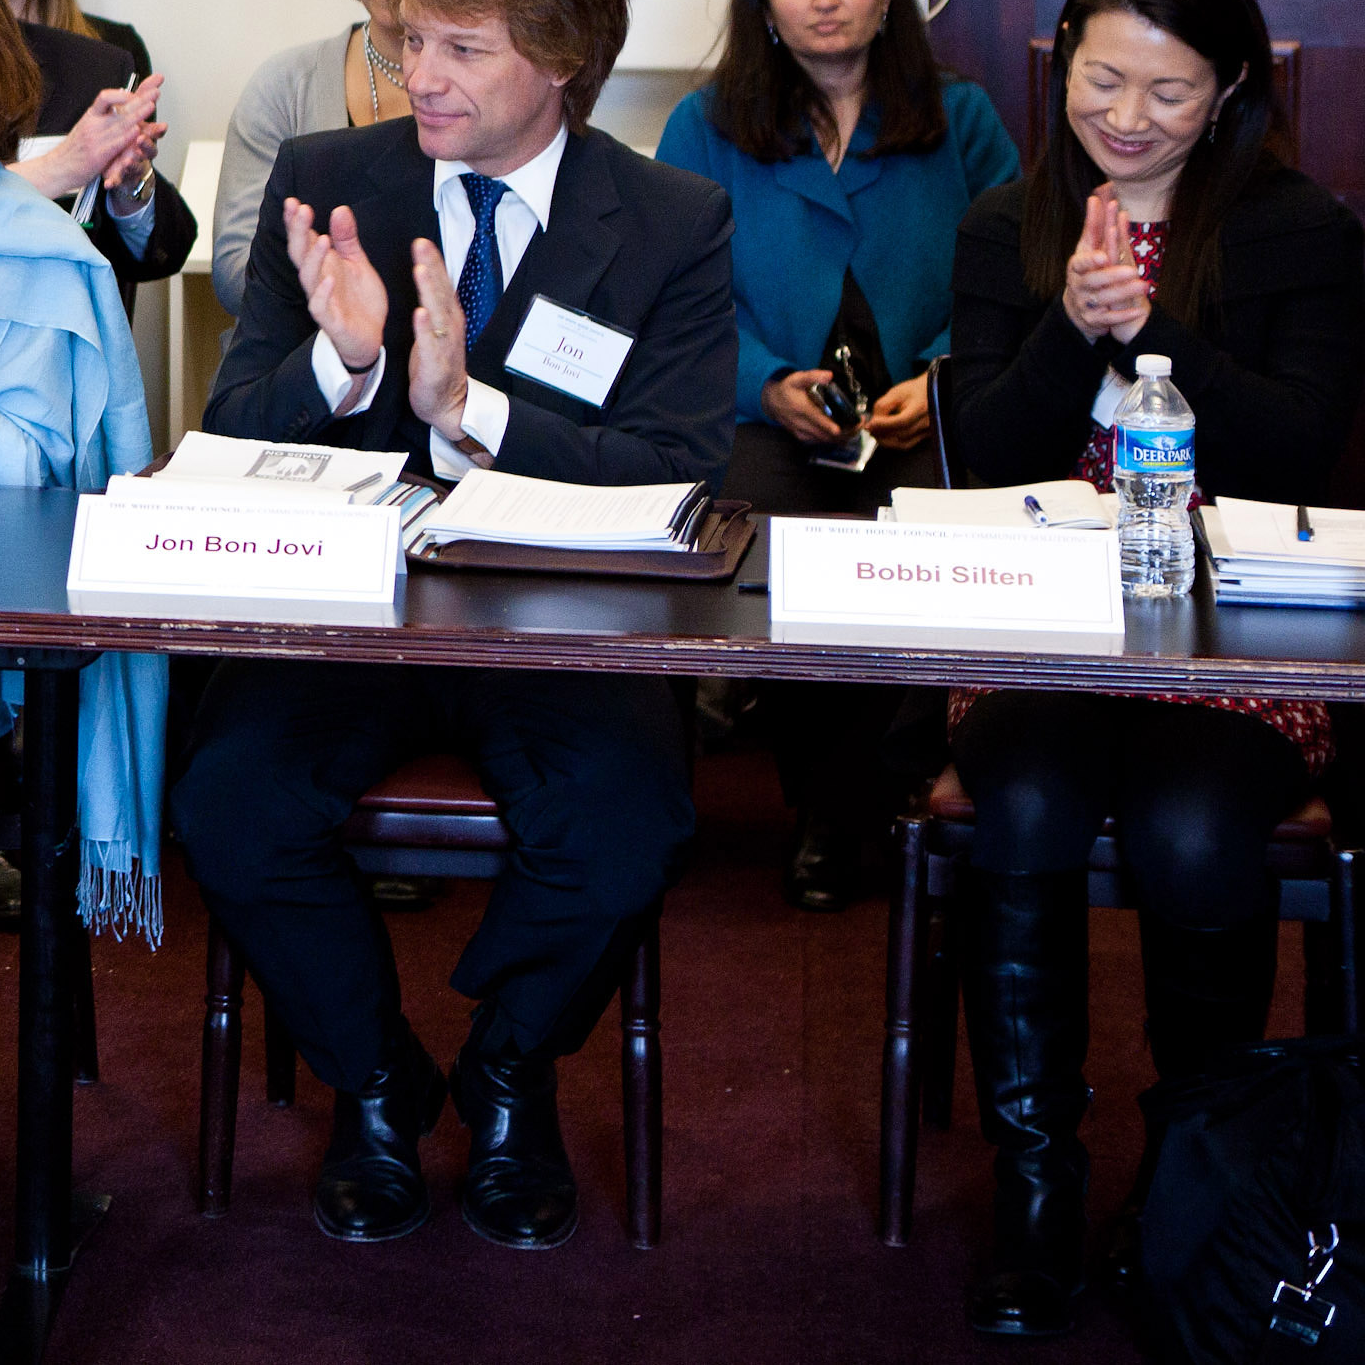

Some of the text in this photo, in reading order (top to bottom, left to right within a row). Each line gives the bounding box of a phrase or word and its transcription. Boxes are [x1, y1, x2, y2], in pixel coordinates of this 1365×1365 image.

[552, 337, 585, 361] Jon
[542, 356, 581, 380] Bon Jovi
[1133, 446, 1192, 462] DEER PARK
[145, 534, 323, 556] Jon Bon Jovi
[856, 562, 1034, 586] Bobbi Silten
